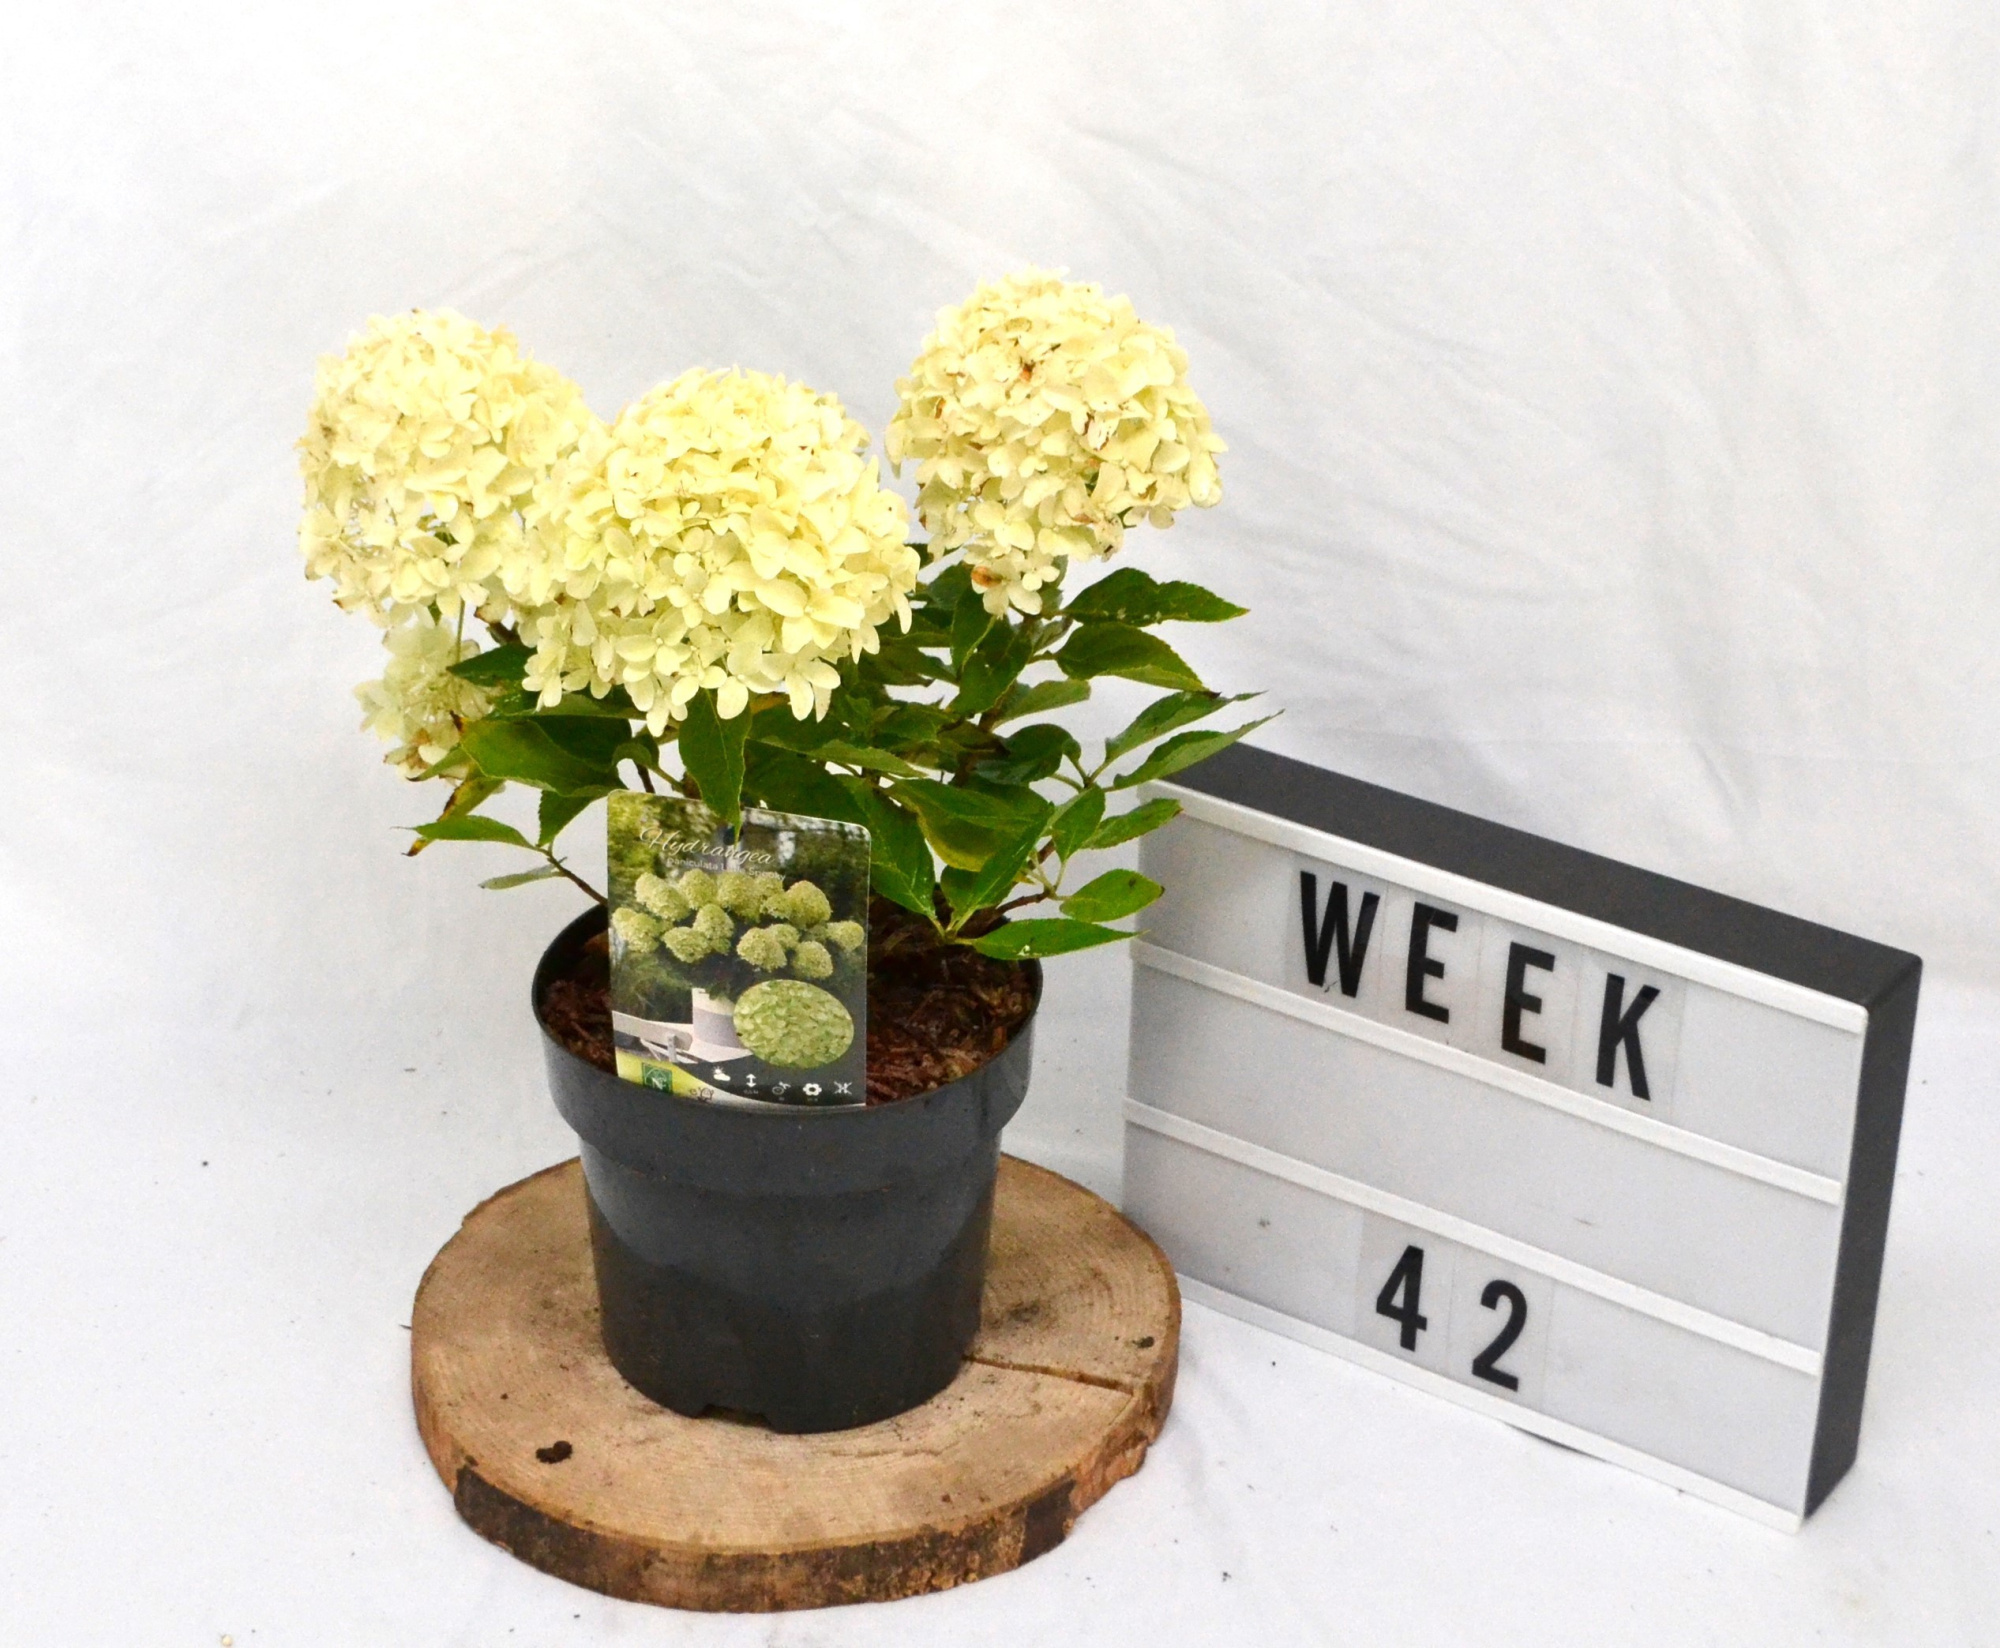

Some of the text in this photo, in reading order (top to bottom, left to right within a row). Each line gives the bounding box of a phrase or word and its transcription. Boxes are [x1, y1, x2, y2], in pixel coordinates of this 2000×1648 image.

[640, 828, 775, 865] Hydrangea
[1300, 870, 1661, 1101] WEEK
[1376, 1244, 1528, 1392] 42
